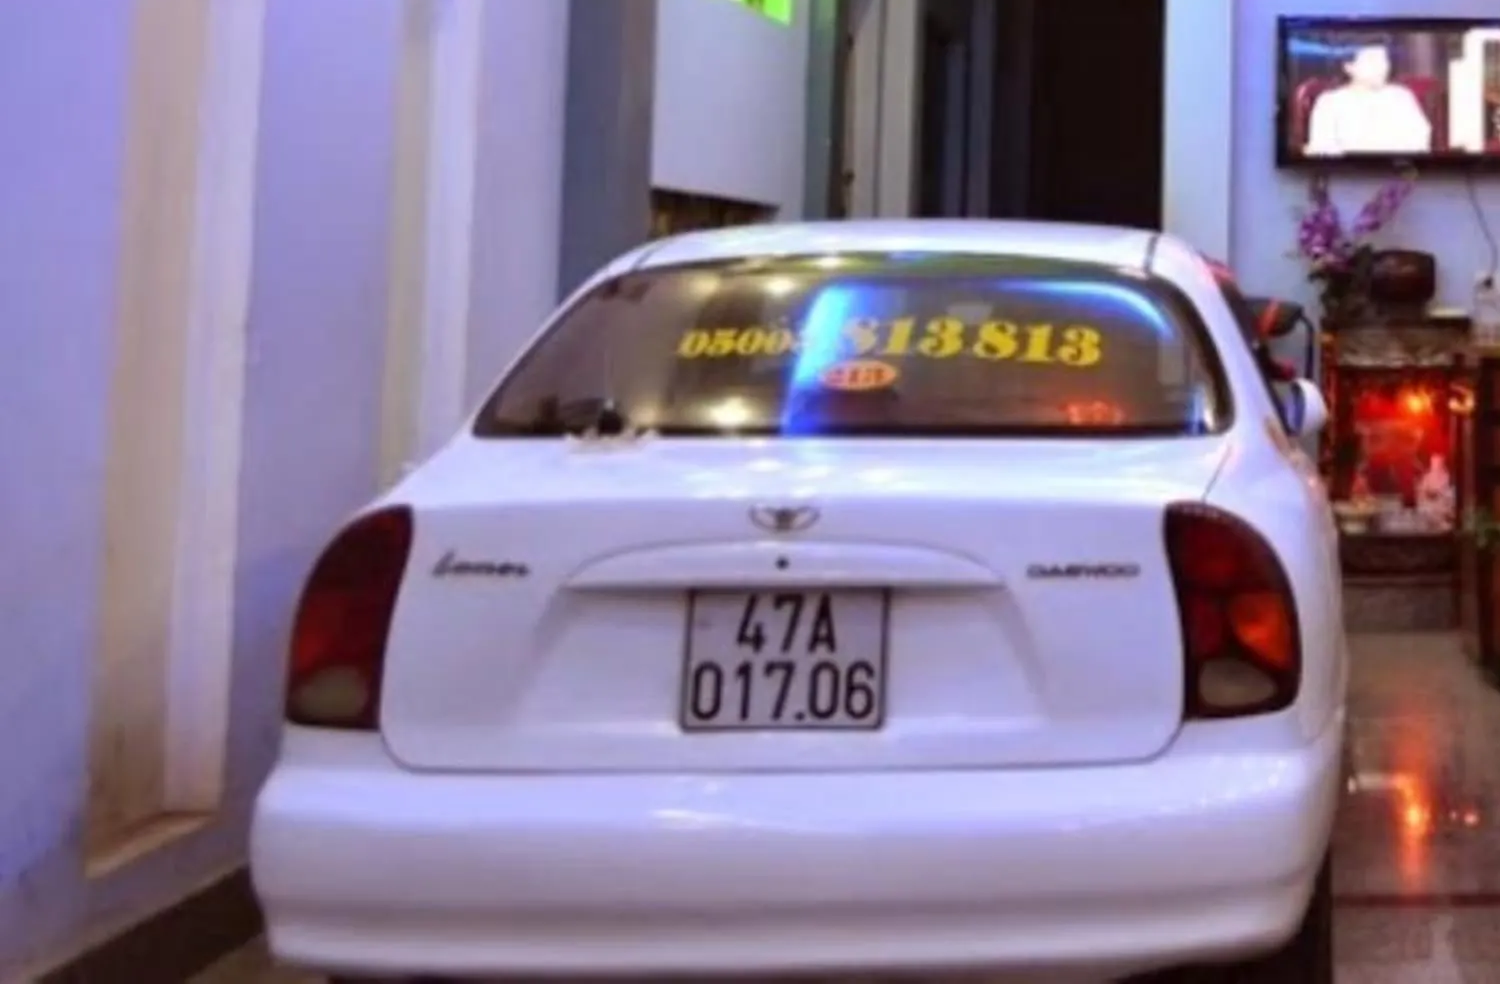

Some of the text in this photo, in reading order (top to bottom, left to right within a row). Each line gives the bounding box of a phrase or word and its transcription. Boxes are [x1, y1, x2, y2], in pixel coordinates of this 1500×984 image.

[1024, 561, 1142, 579] DAEWOO
[736, 591, 837, 655] 47A
[690, 660, 877, 721] 017.06
